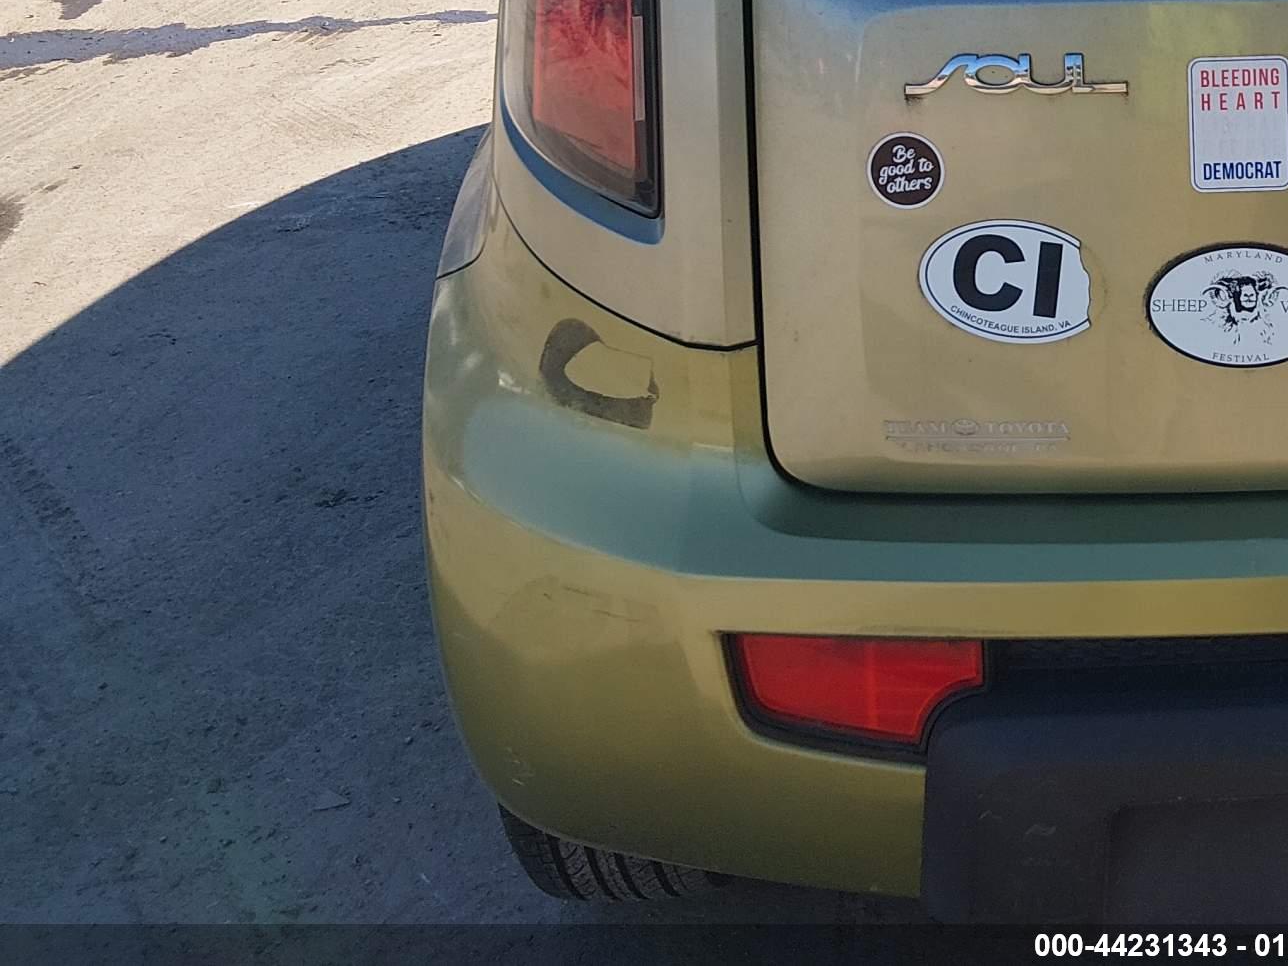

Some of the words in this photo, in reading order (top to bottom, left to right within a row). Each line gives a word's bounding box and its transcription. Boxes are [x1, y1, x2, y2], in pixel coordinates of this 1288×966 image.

[905, 53, 1129, 95] SOUL
[1200, 68, 1279, 88] BLEEDING
[1201, 91, 1280, 111] HEART
[892, 144, 916, 163] Be
[878, 159, 916, 185] good
[917, 157, 934, 172] to
[1203, 161, 1281, 181] DEMOCRAT
[886, 175, 933, 193] others
[1204, 251, 1284, 265] MARYLAND
[953, 234, 1063, 318] CI
[1152, 298, 1208, 312] SHEEP
[951, 305, 1019, 333] CHINCOTEAGUE
[1059, 320, 1071, 329] VA
[1212, 351, 1270, 363] FESTIVAL
